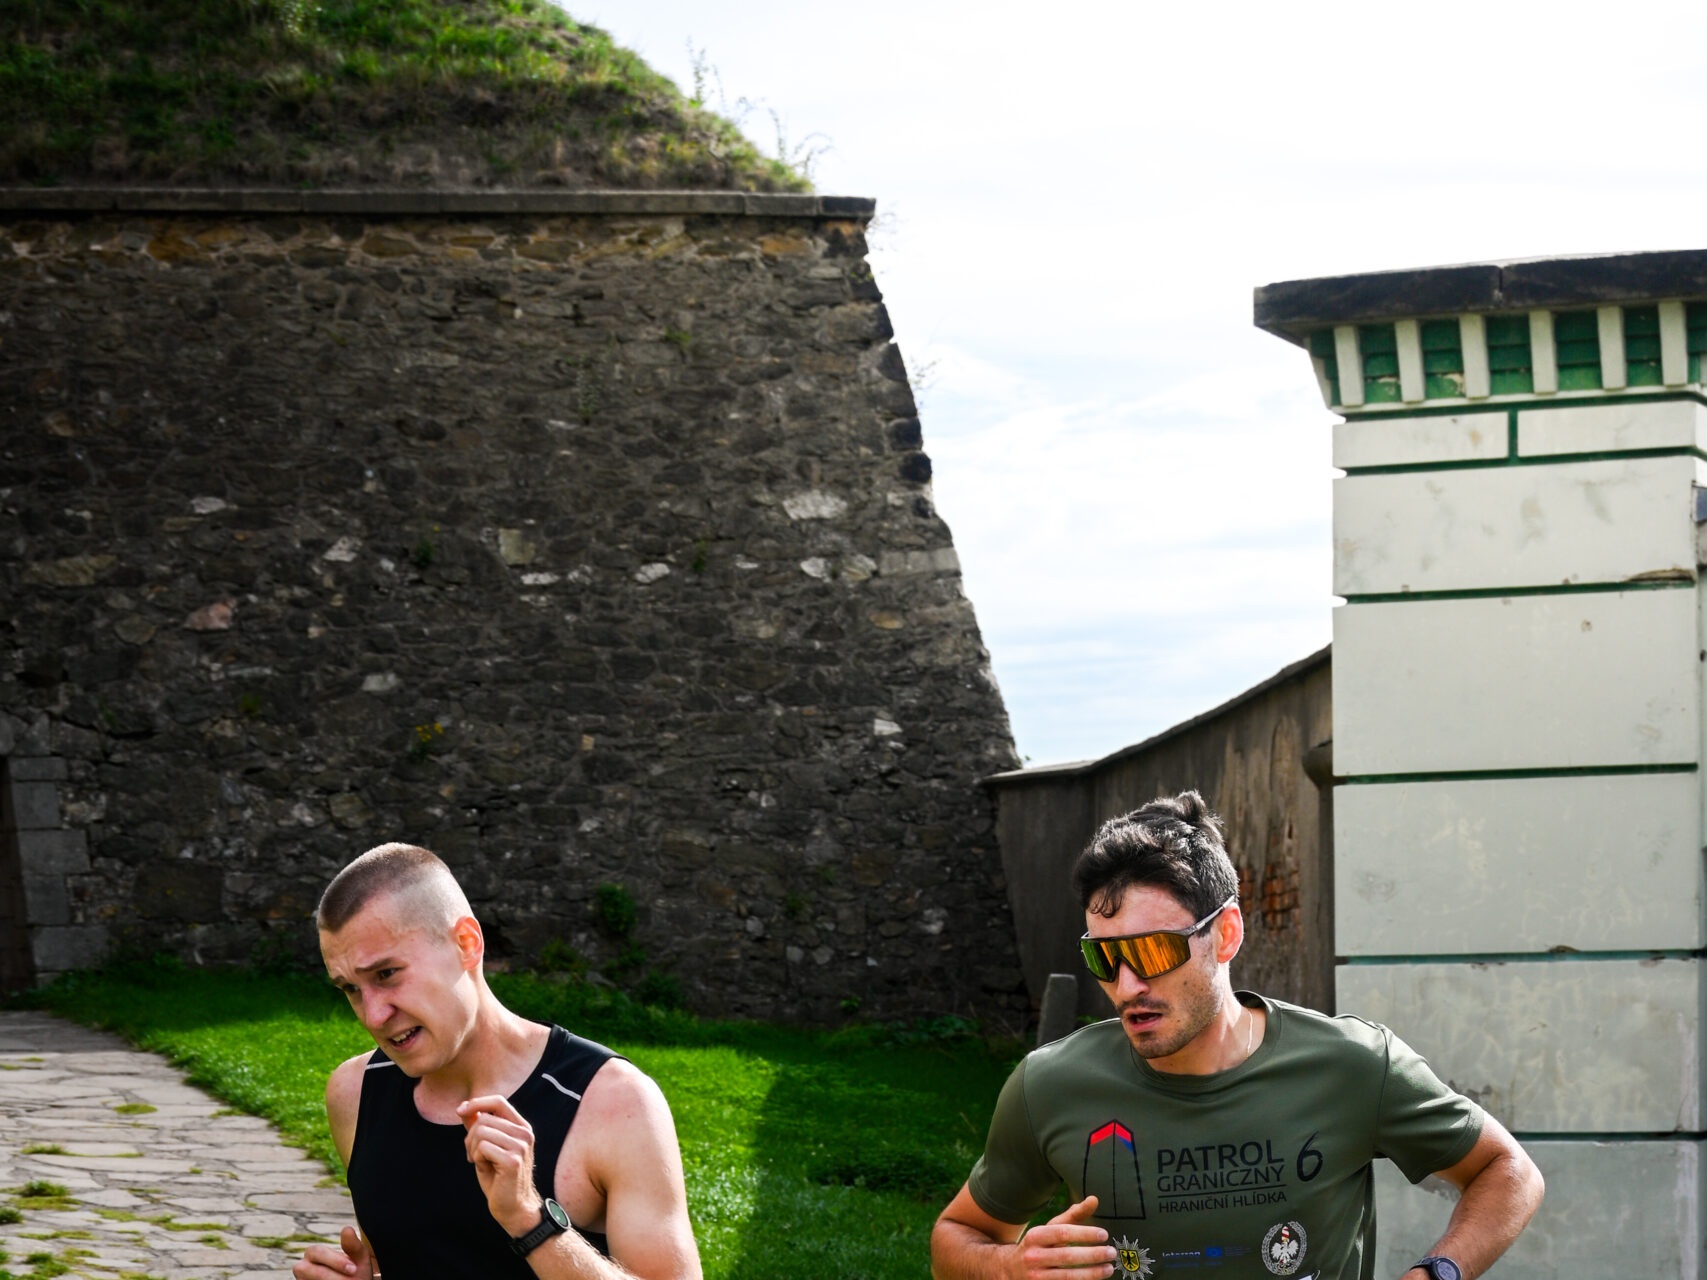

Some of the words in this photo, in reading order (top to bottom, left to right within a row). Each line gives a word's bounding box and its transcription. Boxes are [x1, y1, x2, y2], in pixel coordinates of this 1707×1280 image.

[1157, 1139, 1285, 1174] PATROL
[1296, 1130, 1324, 1182] 6
[1157, 1164, 1285, 1193] GRANICZNY
[1158, 1194, 1230, 1213] HRANIČNÍ
[1233, 1189, 1287, 1207] HLÍDKA
